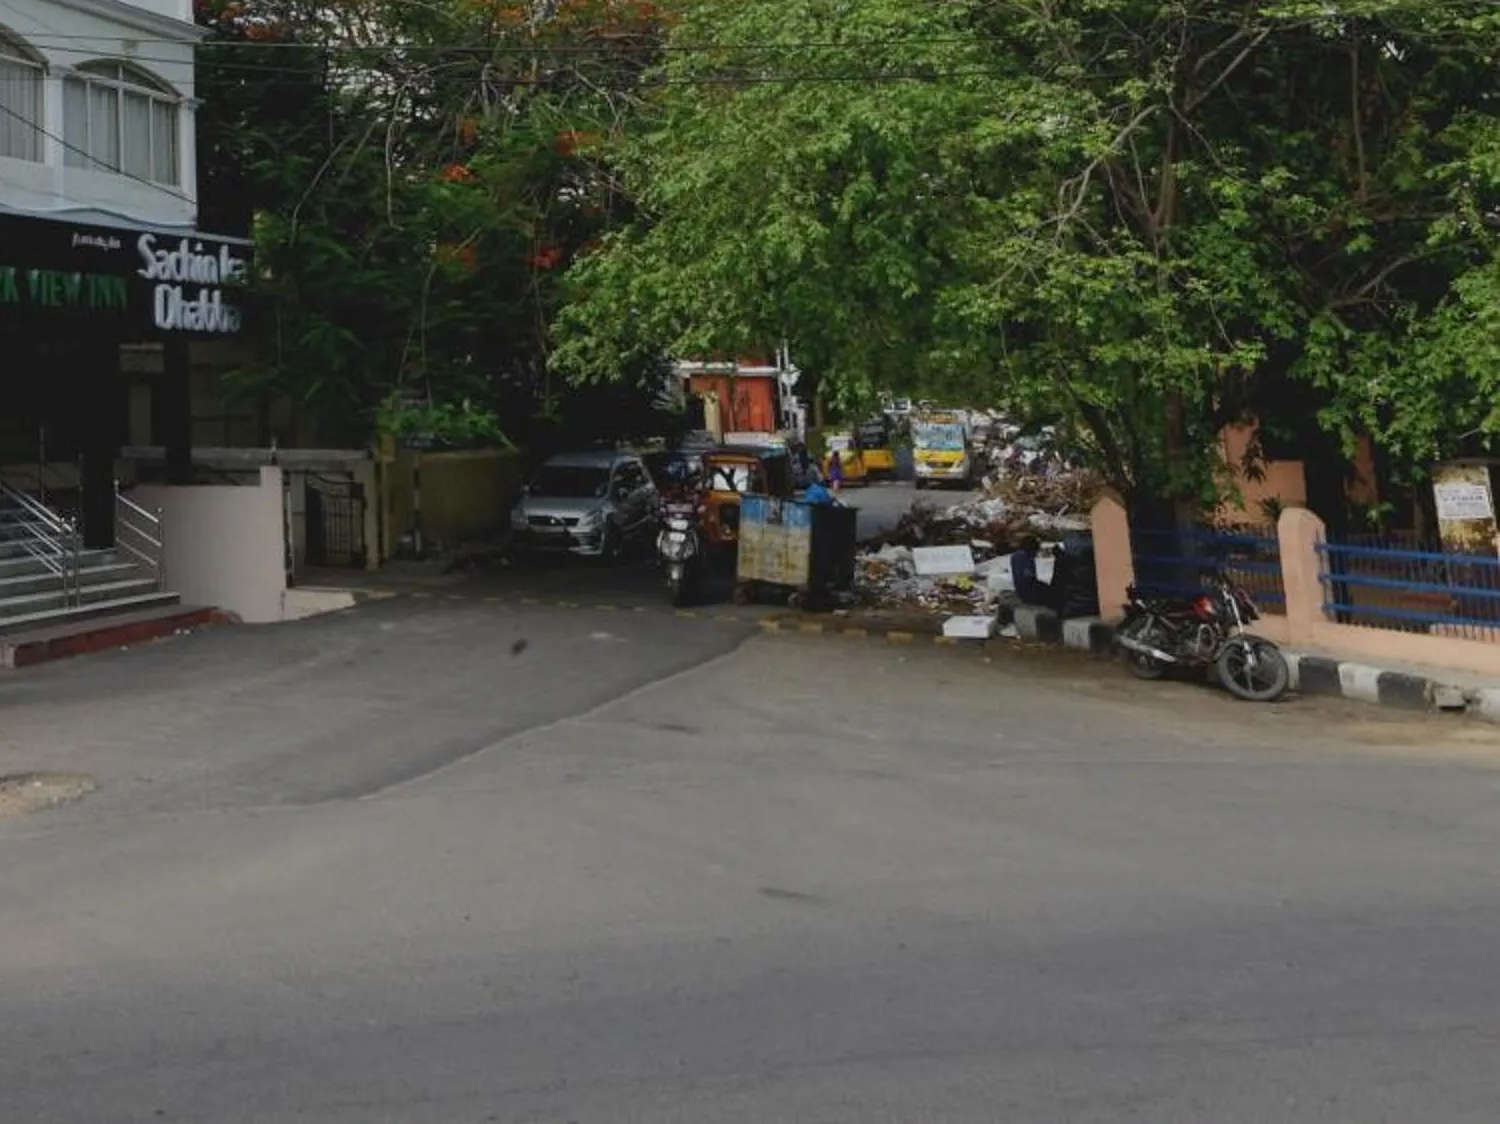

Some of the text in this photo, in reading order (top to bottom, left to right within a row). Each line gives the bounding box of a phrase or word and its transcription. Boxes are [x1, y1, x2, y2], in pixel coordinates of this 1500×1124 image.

[135, 233, 219, 284] Sachin
[26, 268, 82, 308] VIEW
[85, 272, 128, 312] INN
